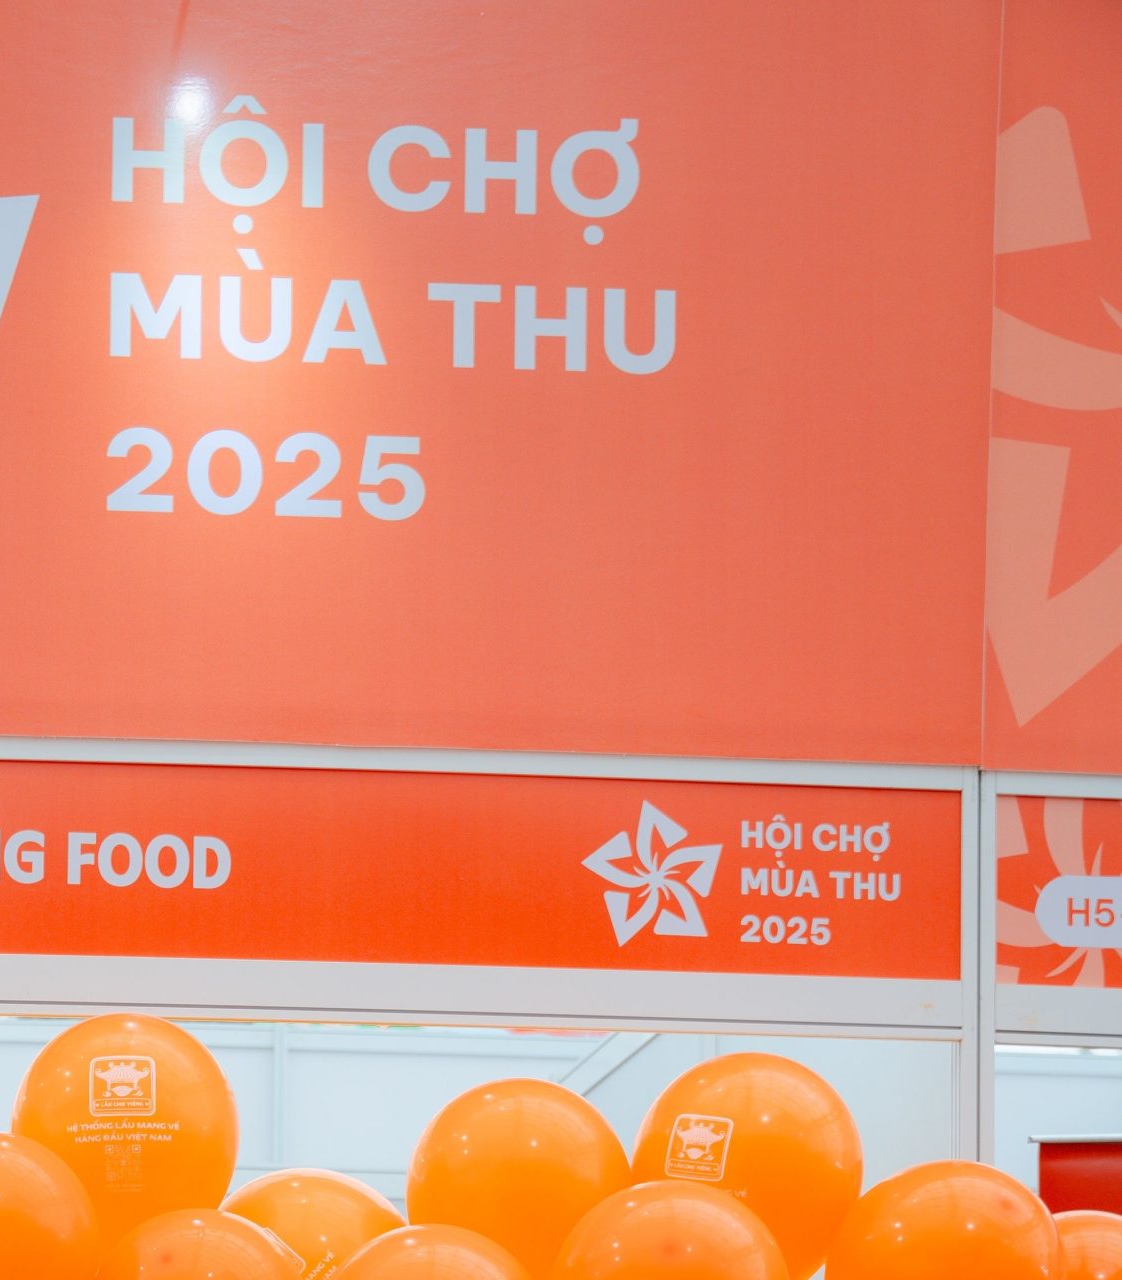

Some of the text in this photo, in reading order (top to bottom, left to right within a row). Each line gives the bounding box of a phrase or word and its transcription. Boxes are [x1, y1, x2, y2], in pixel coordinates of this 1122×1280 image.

[111, 95, 640, 245] HỘI CHỢ
[109, 249, 676, 375] MÙA THU
[106, 426, 426, 521] 2025
[741, 814, 891, 862] HỘI CHỢ
[67, 831, 232, 890] FOOD
[741, 860, 901, 901] MÙA THU
[740, 914, 831, 945] 2025
[1067, 897, 1122, 928] H5
[137, 1122, 166, 1130] MANG
[149, 1134, 172, 1142] NAM
